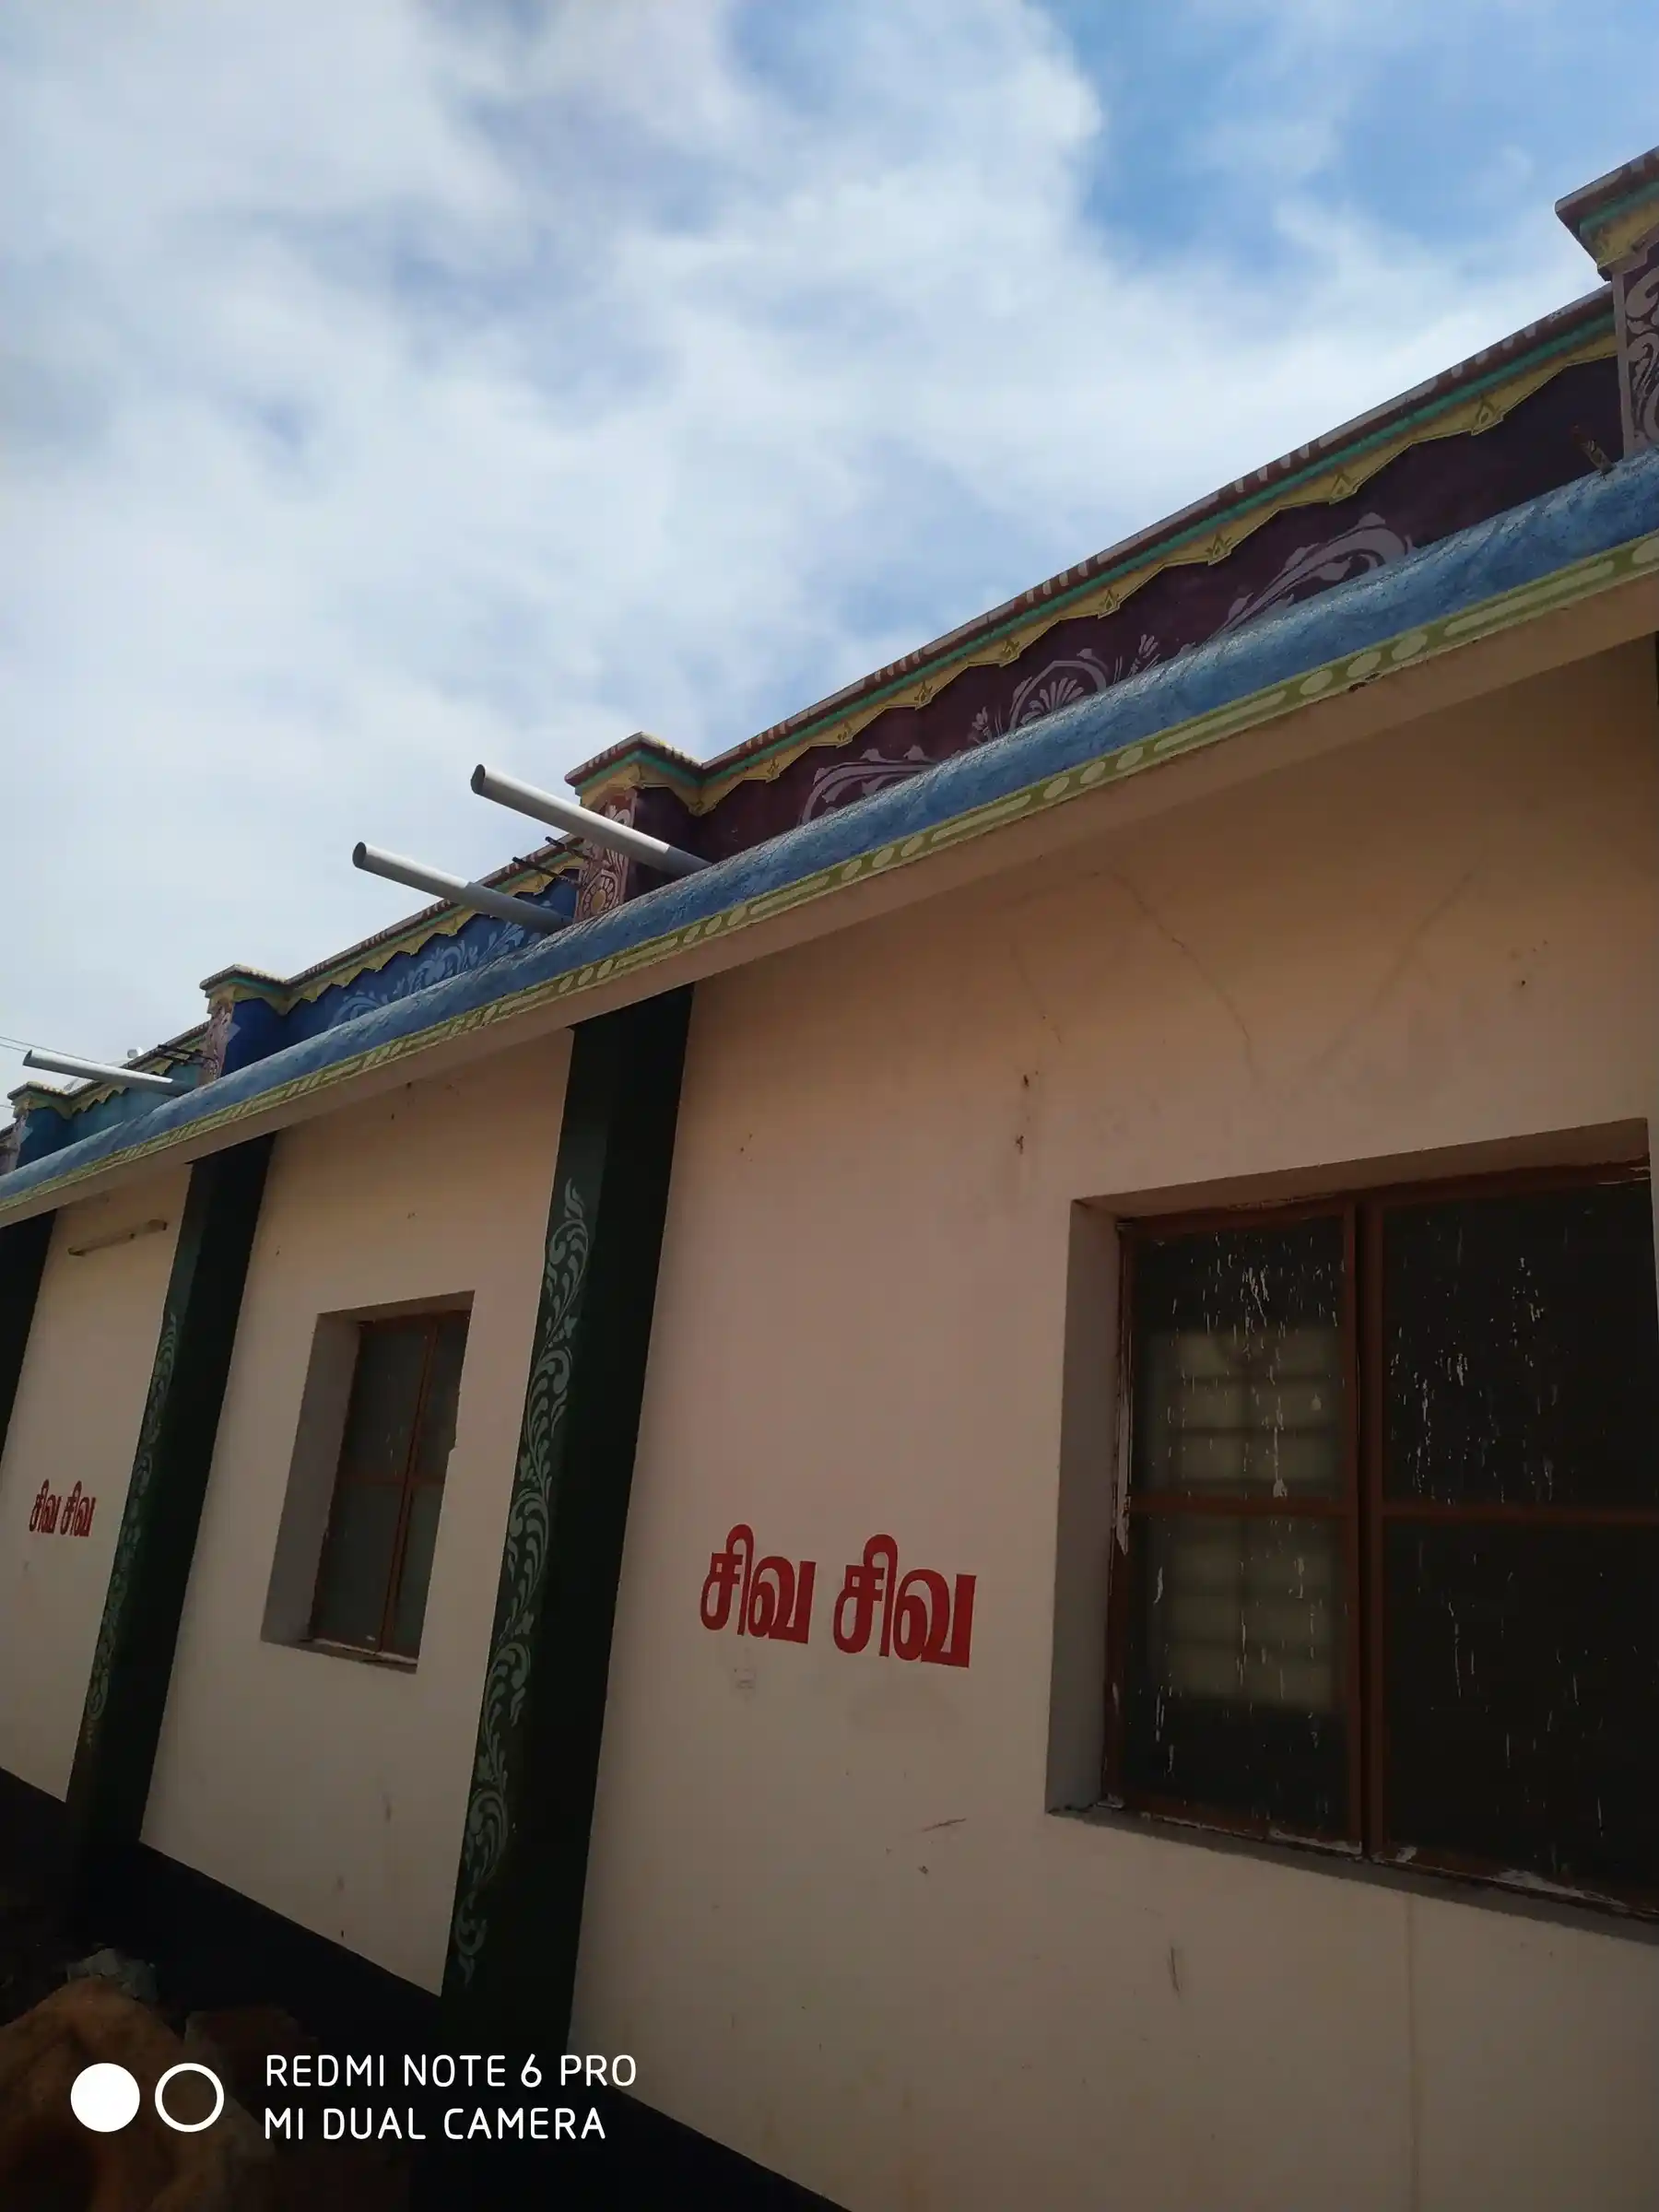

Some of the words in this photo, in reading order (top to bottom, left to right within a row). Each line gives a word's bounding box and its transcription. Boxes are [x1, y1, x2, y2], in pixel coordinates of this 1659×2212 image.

[29, 1478, 62, 1534] சிவ
[60, 1480, 96, 1537] சிவ
[700, 1524, 817, 1644] சிவ
[832, 1534, 977, 1668] சிவ
